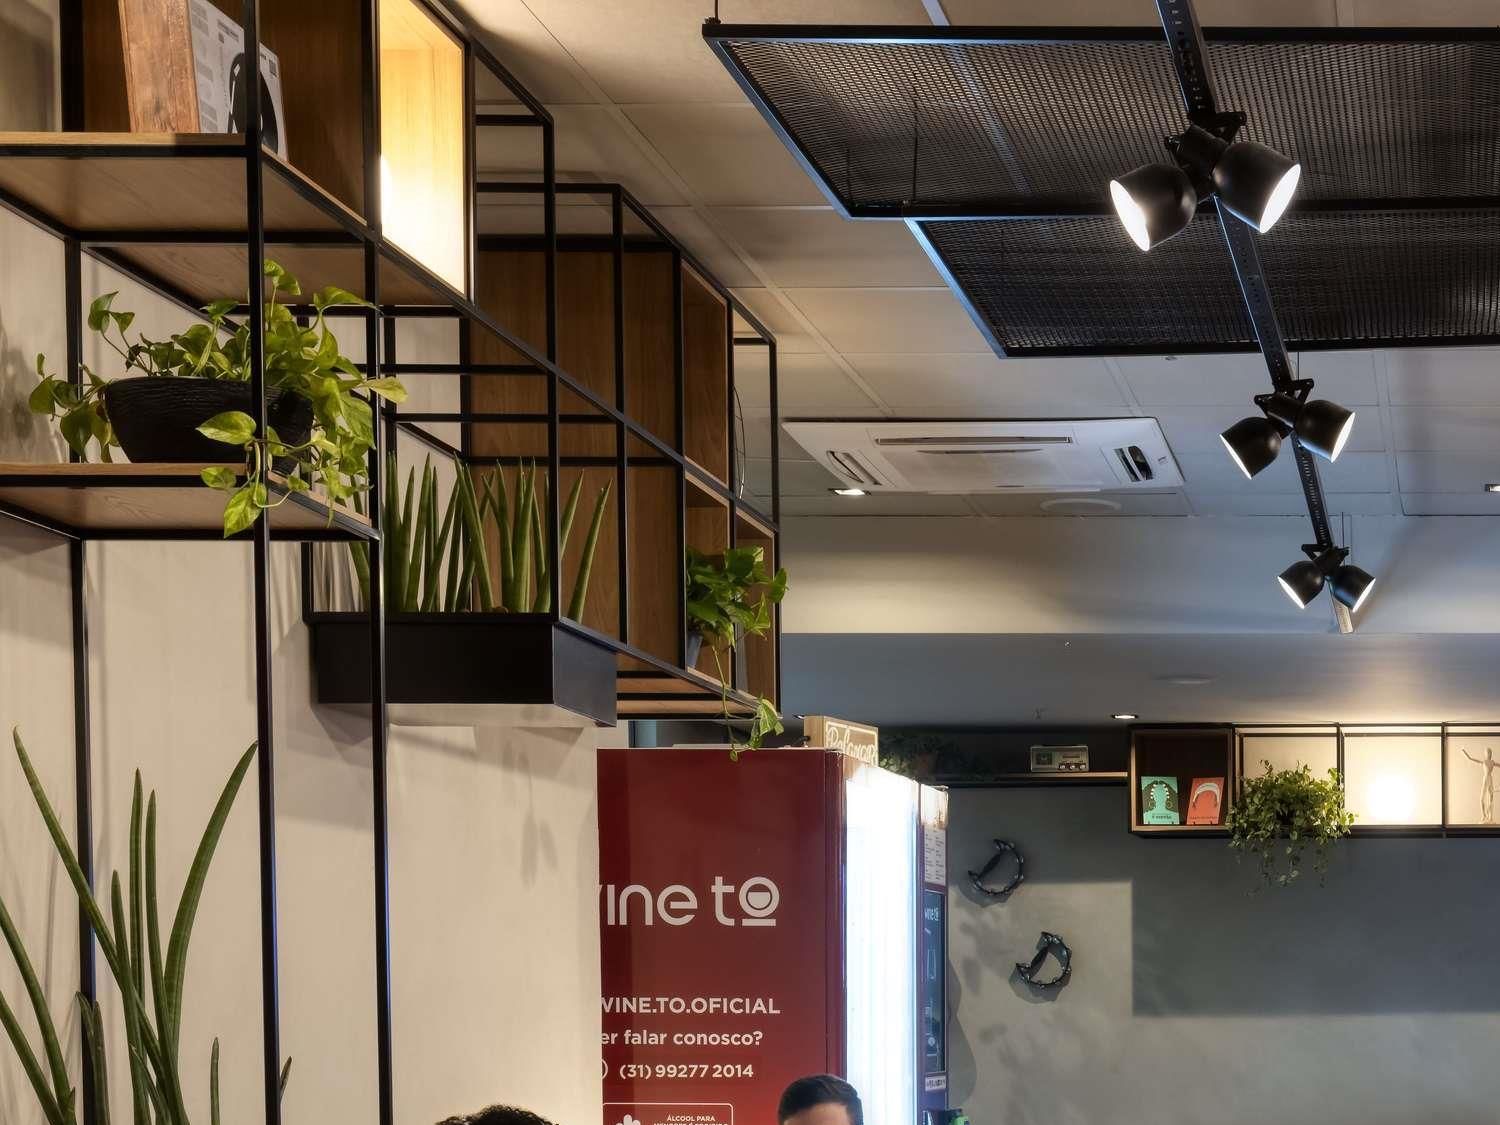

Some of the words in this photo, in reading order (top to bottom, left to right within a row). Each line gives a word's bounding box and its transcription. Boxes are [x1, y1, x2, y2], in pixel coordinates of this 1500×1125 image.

[600, 885, 698, 926] ine
[711, 876, 780, 927] to
[601, 997, 781, 1014] VINE.TO.OFICIAL
[624, 1029, 667, 1045] falar
[673, 1030, 763, 1046] conosco?
[619, 1064, 652, 1080] (31)
[655, 1064, 709, 1078] 99277
[712, 1064, 754, 1078] 2014
[666, 1114, 695, 1122] ÁLCOOL
